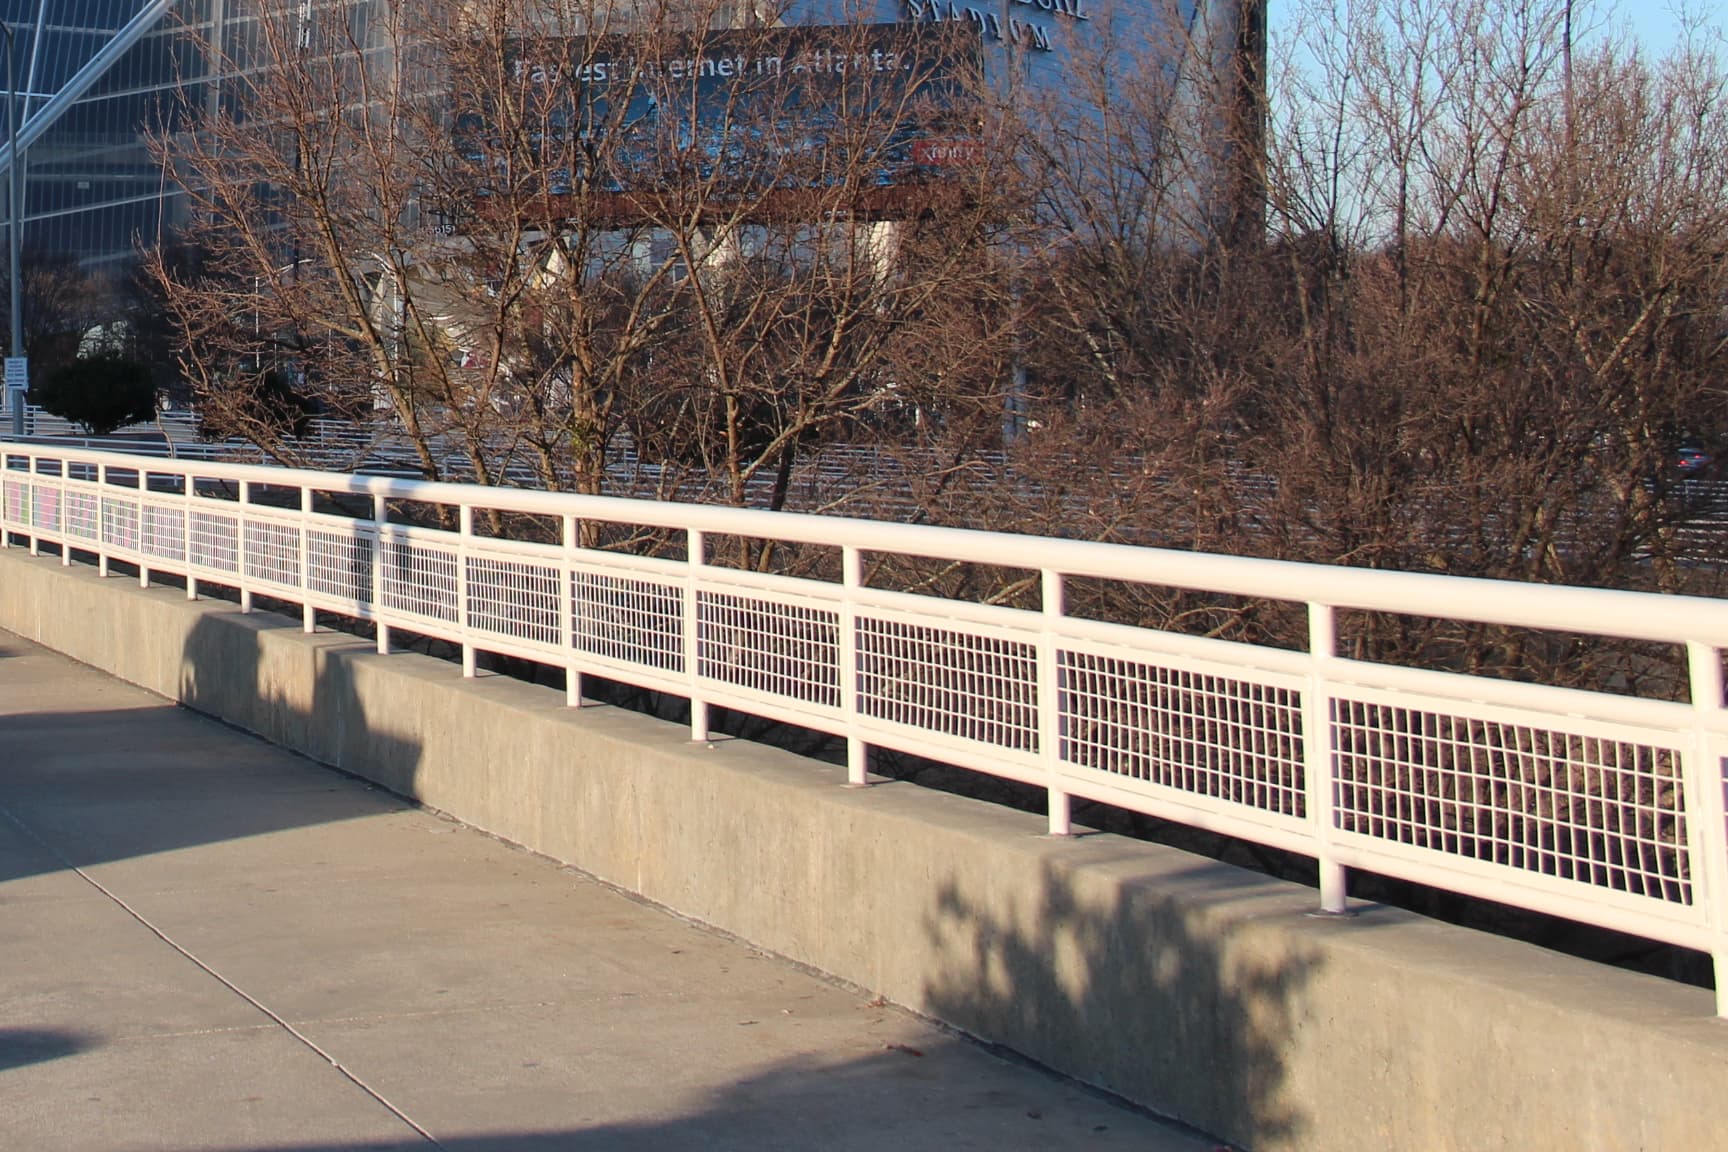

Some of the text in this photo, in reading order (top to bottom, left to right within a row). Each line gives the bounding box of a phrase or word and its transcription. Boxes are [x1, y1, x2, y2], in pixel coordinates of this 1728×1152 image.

[514, 59, 618, 83] Fasest
[628, 54, 748, 78] Inernet
[756, 55, 782, 75] in
